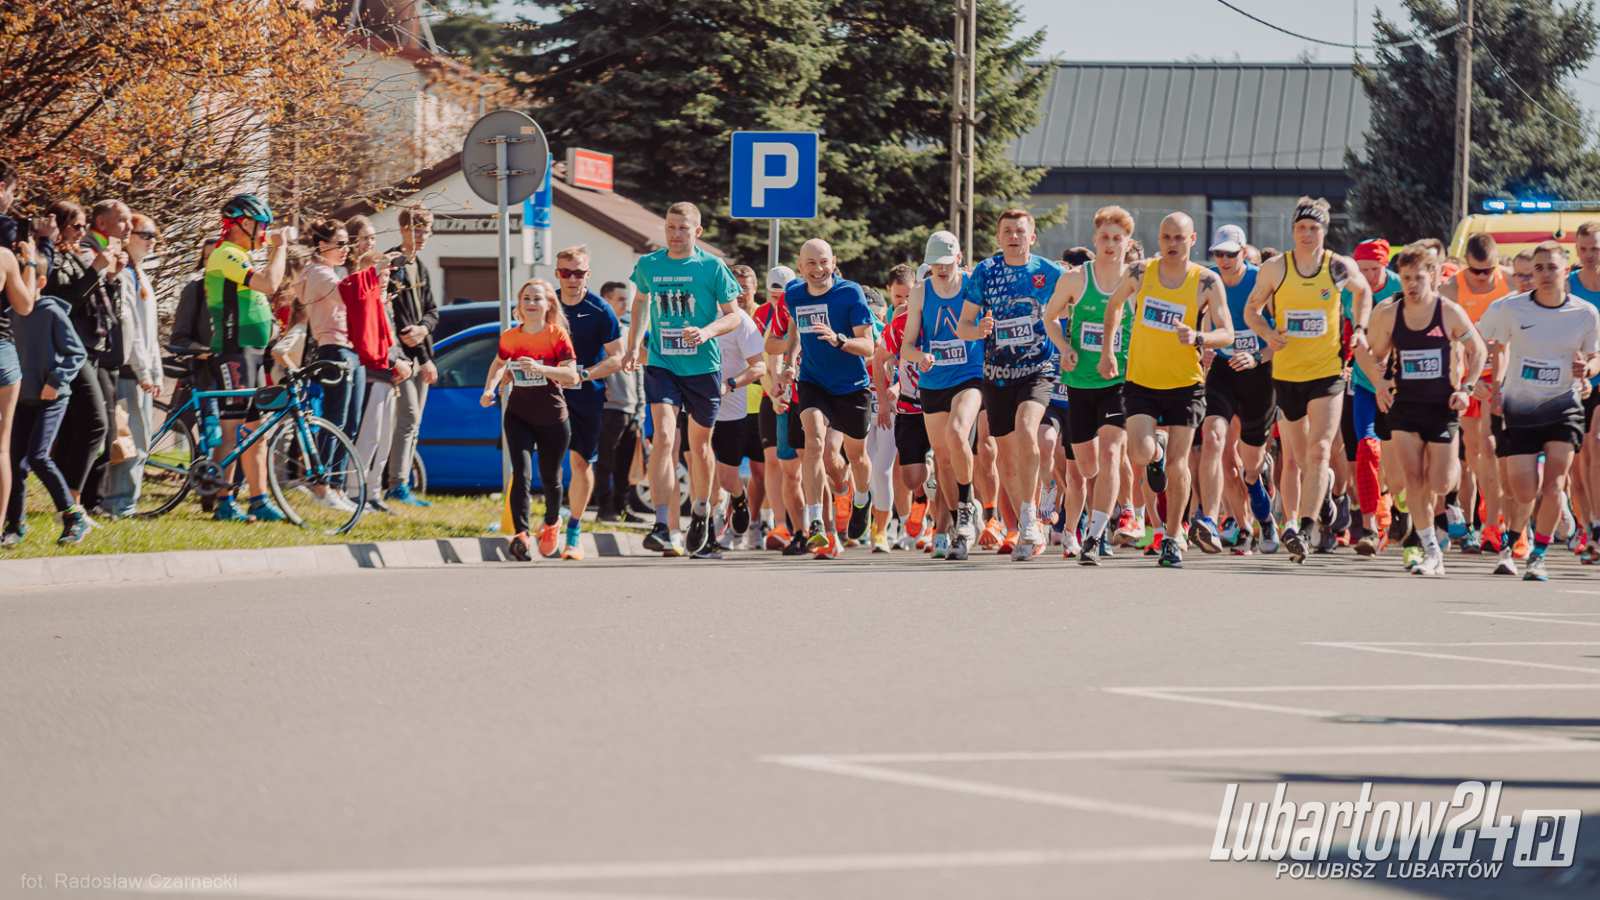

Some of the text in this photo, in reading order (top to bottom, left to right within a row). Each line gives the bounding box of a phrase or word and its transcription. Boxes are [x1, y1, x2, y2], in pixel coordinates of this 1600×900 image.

[752, 142, 799, 208] P
[1010, 325, 1031, 338] 124
[1235, 336, 1256, 349] 024
[945, 347, 963, 359] 107
